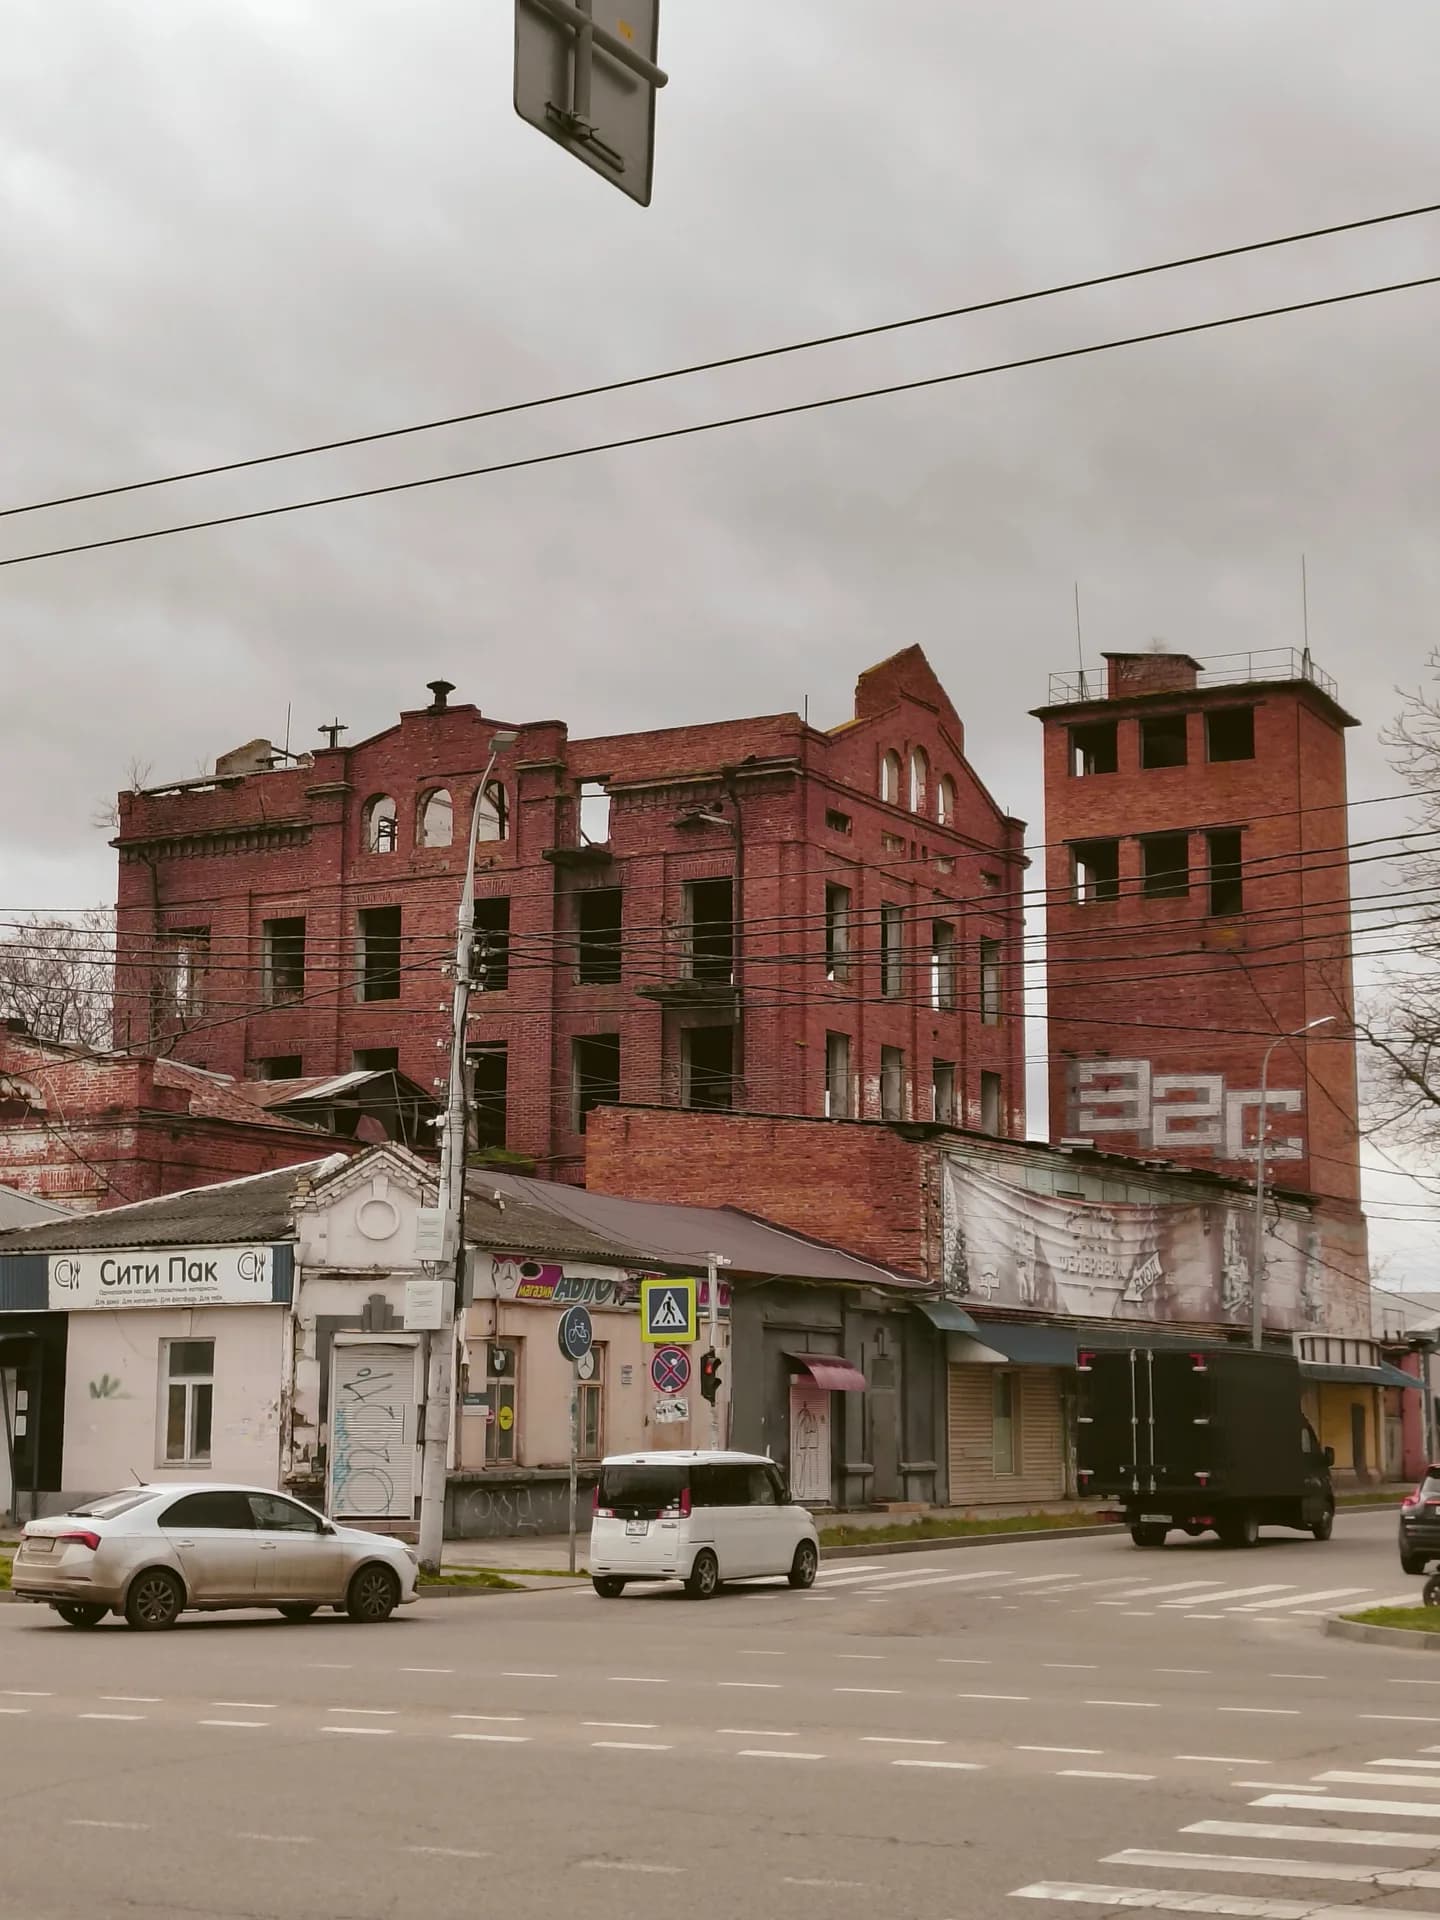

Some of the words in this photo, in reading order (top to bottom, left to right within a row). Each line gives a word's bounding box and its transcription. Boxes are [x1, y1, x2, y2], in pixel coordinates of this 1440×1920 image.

[100, 1259, 160, 1286] Сити
[168, 1256, 219, 1283] Пак
[1134, 1258, 1159, 1294] ВХОД
